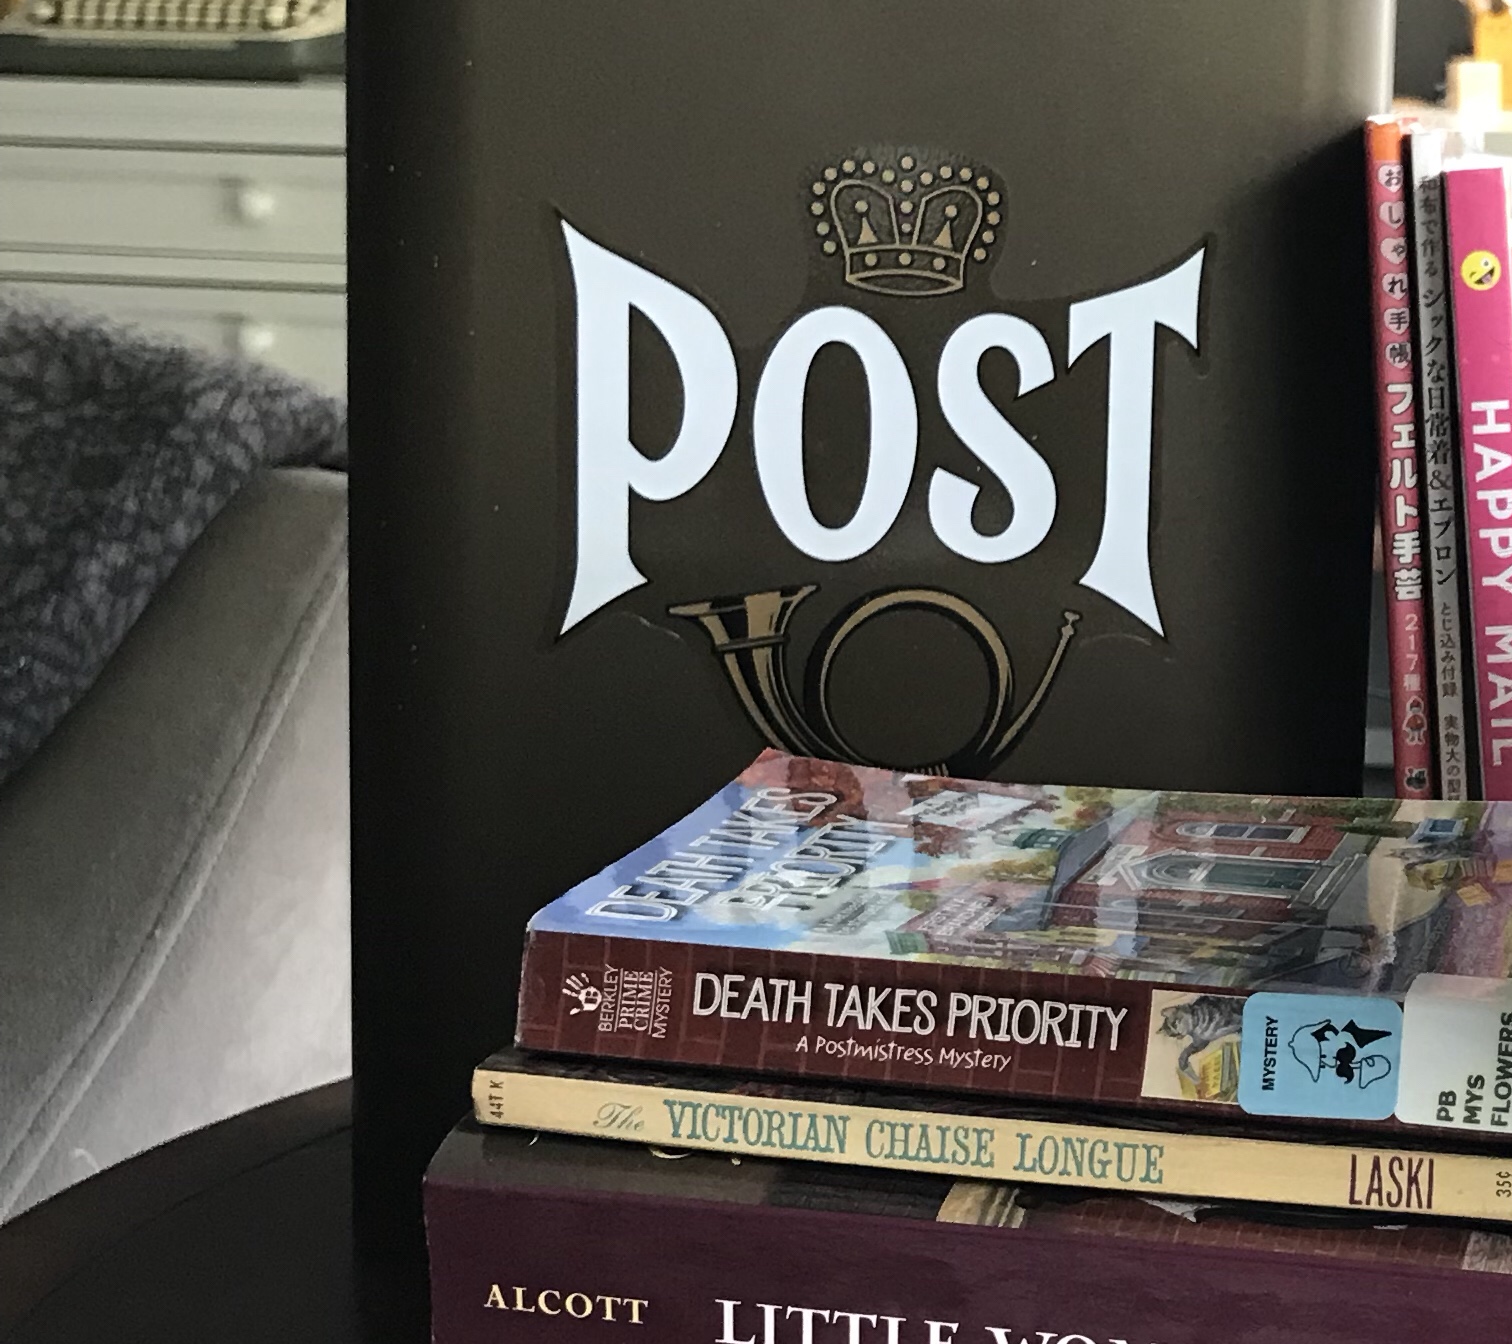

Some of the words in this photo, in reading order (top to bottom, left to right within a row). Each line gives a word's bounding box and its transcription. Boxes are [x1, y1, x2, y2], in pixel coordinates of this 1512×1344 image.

[558, 217, 1207, 639] POST
[585, 850, 709, 922] DEATH
[689, 786, 838, 851] TAKES
[719, 813, 912, 912] PRIORITY
[598, 963, 619, 1033] BERKLEY
[618, 970, 639, 1030] PRIME
[633, 971, 655, 1032] CRIME
[651, 966, 673, 1039] MYSTERY
[692, 972, 812, 1025] DEATH
[824, 983, 938, 1037] TAKES
[946, 992, 1129, 1051] PRIORITY
[795, 1035, 809, 1053] A
[815, 1036, 934, 1066] Postmistress
[938, 1046, 1012, 1072] Mystery
[1261, 1015, 1279, 1091] MYSTERY
[1436, 1090, 1457, 1123] PB
[1462, 1074, 1486, 1125] MYS
[592, 1102, 645, 1132] The
[663, 1098, 851, 1155] VICTORIAN
[865, 1119, 996, 1169] CHAISE
[1011, 1132, 1165, 1185] LONGUE
[1348, 1154, 1435, 1210] LASKI
[484, 1283, 648, 1324] ALCOTT
